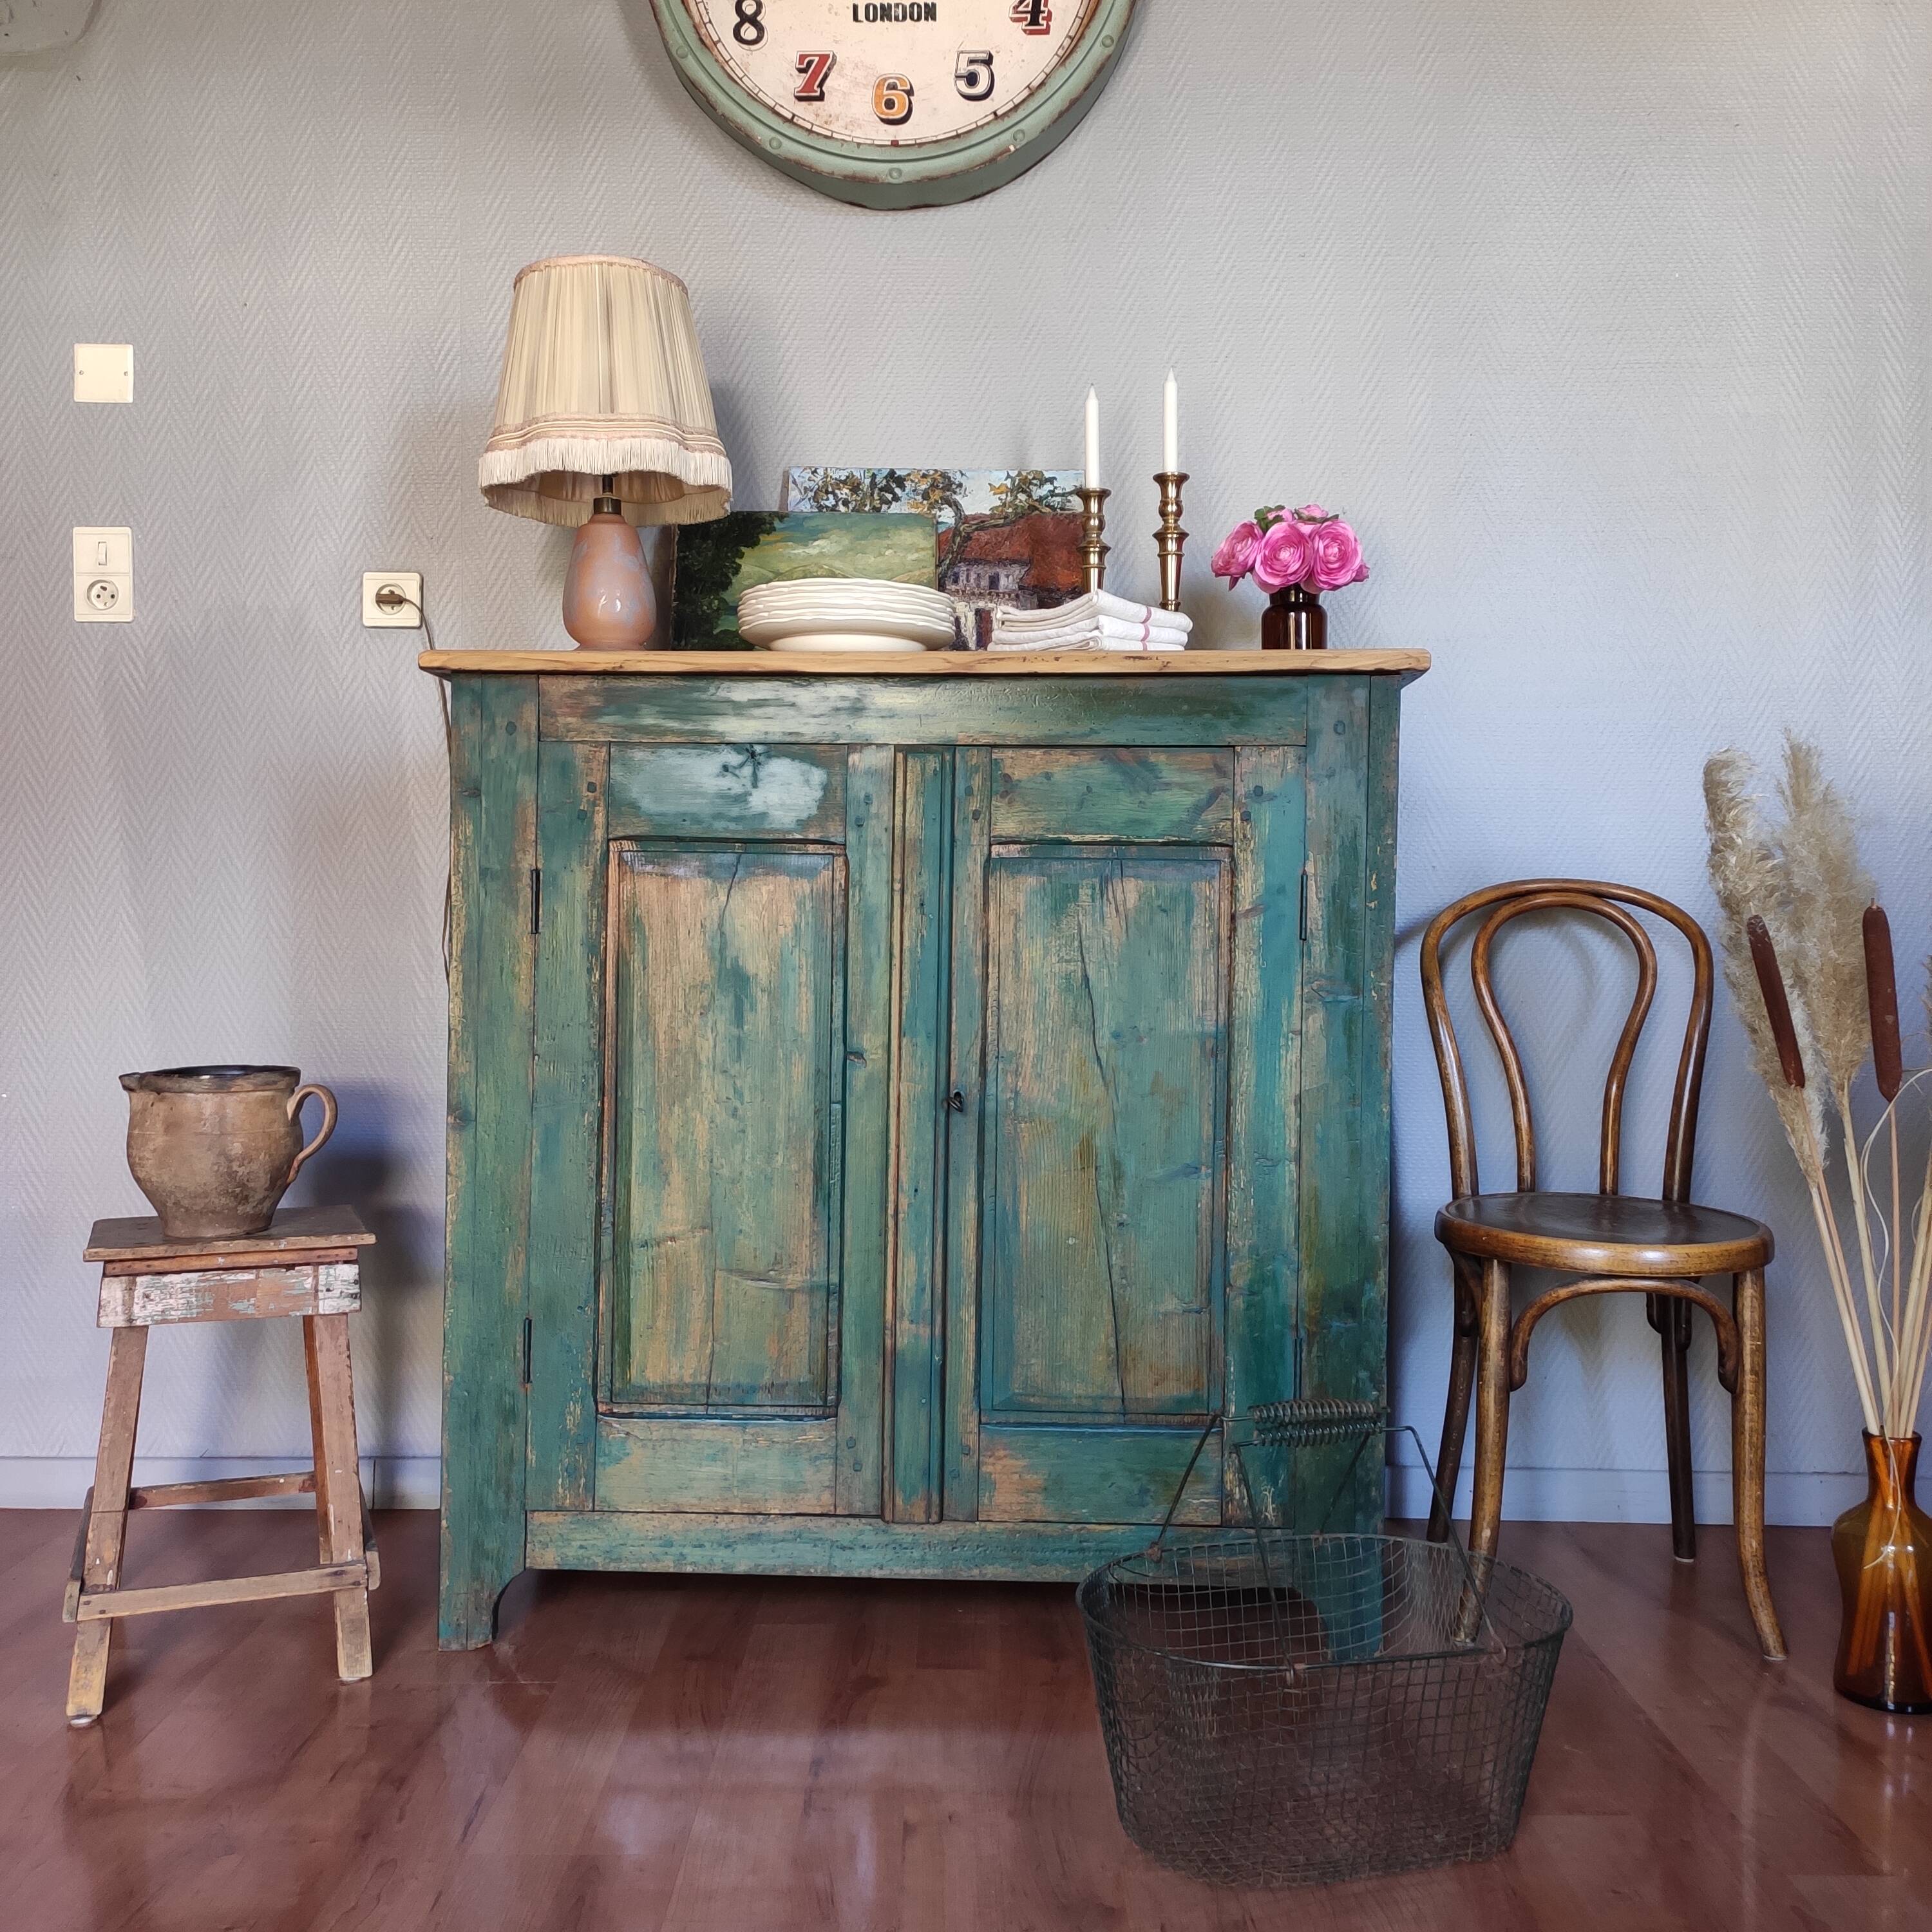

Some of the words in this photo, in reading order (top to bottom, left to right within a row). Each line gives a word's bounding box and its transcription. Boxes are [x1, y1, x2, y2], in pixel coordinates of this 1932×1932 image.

[733, 0, 768, 52] 8
[853, 2, 936, 23] LONDON
[1009, 0, 1052, 35] 4
[793, 50, 837, 102] 7
[871, 73, 914, 126] 6
[954, 50, 995, 102] 5
